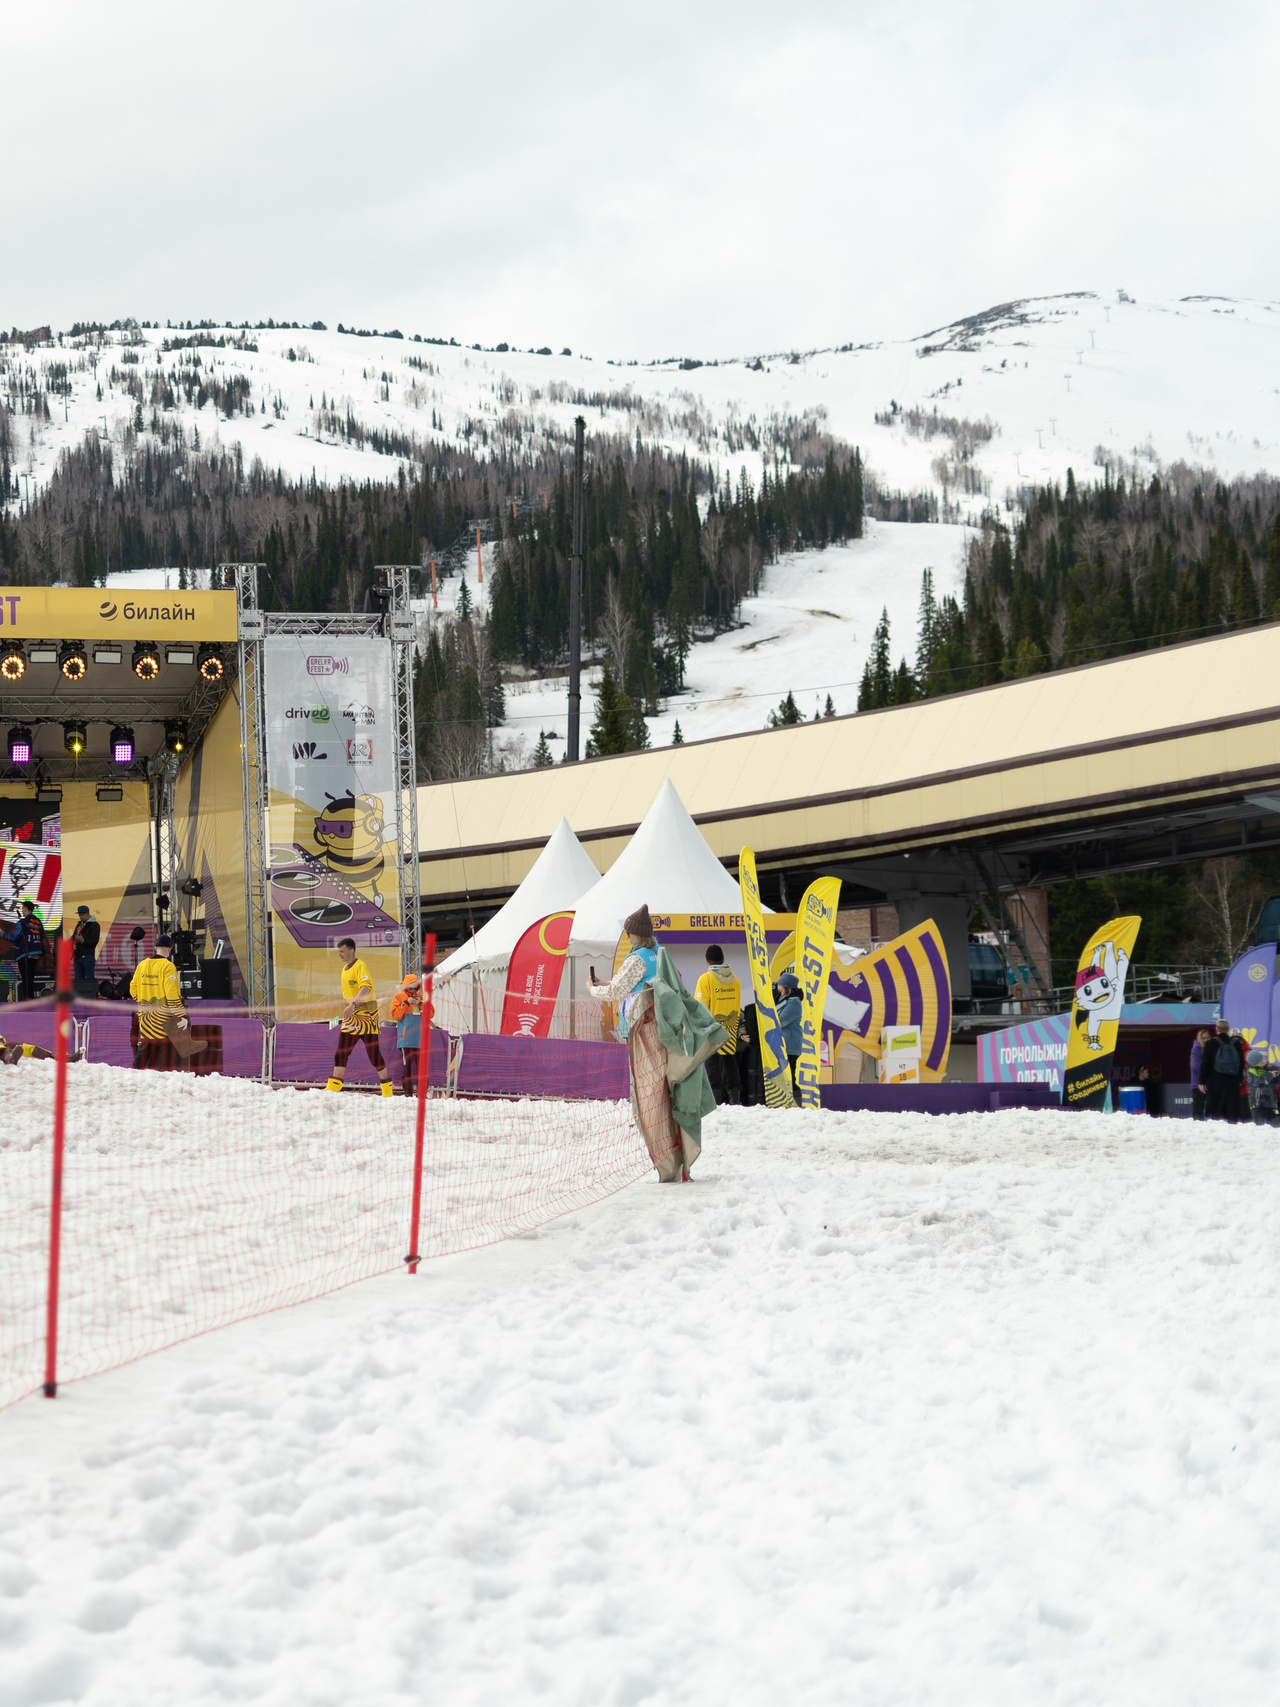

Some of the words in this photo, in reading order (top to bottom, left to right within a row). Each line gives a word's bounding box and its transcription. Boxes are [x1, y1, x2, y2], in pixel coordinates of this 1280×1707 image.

[122, 602, 196, 621] билайн
[689, 916, 725, 927] GRELKA
[730, 916, 745, 927] FES
[1000, 1043, 1068, 1064] ГОРНОЛЫЖНА
[1017, 1068, 1059, 1087] ОДЕЖДА
[1068, 1079, 1108, 1101] соединяет
